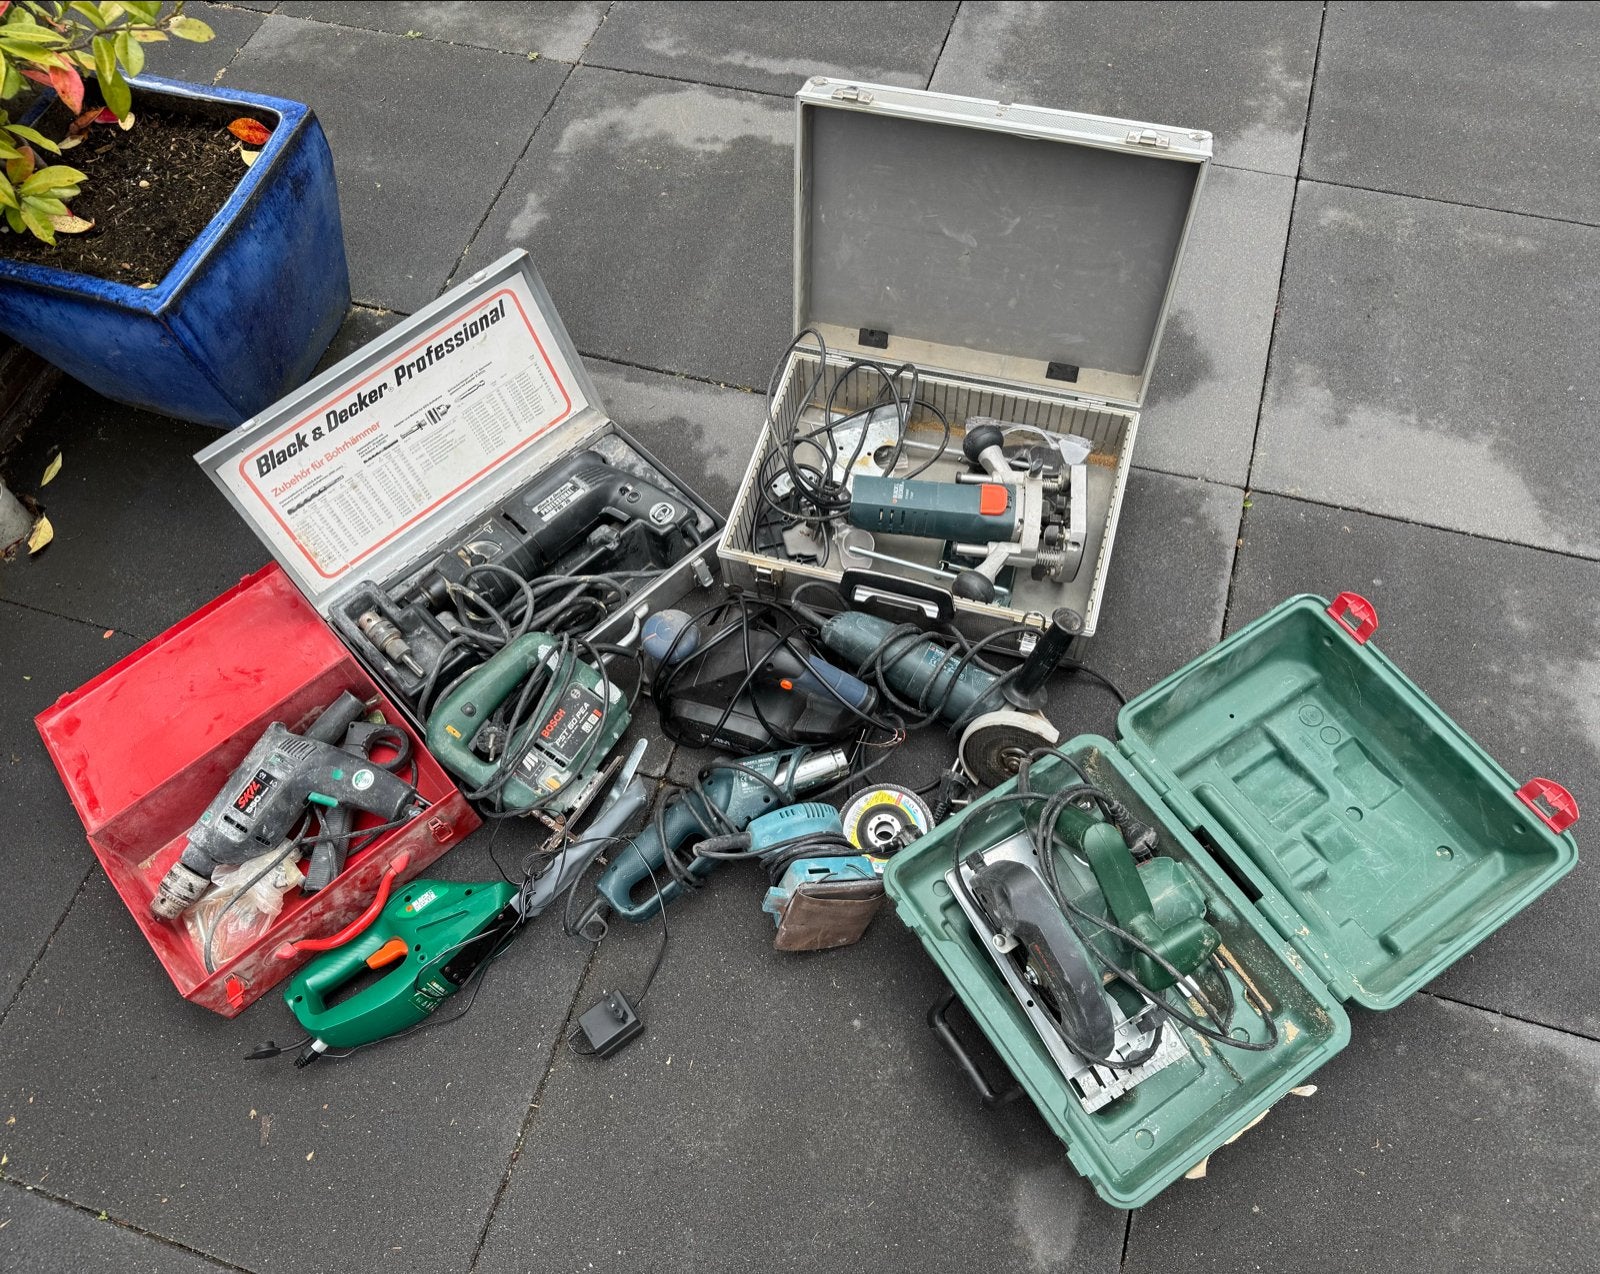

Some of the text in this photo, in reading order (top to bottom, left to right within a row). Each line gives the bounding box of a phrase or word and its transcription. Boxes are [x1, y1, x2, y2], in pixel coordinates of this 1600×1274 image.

[256, 432, 309, 478] Black
[311, 426, 325, 441] &
[325, 383, 388, 432] Decker
[394, 299, 506, 387] Professional
[271, 467, 312, 497] Zubehör
[310, 459, 325, 472] für
[324, 421, 381, 462] Bohrhämmer
[541, 708, 566, 738] BOSCH
[555, 728, 569, 747] PST
[567, 717, 578, 730] 60
[575, 702, 590, 719] PEA
[238, 781, 261, 809] SKIL
